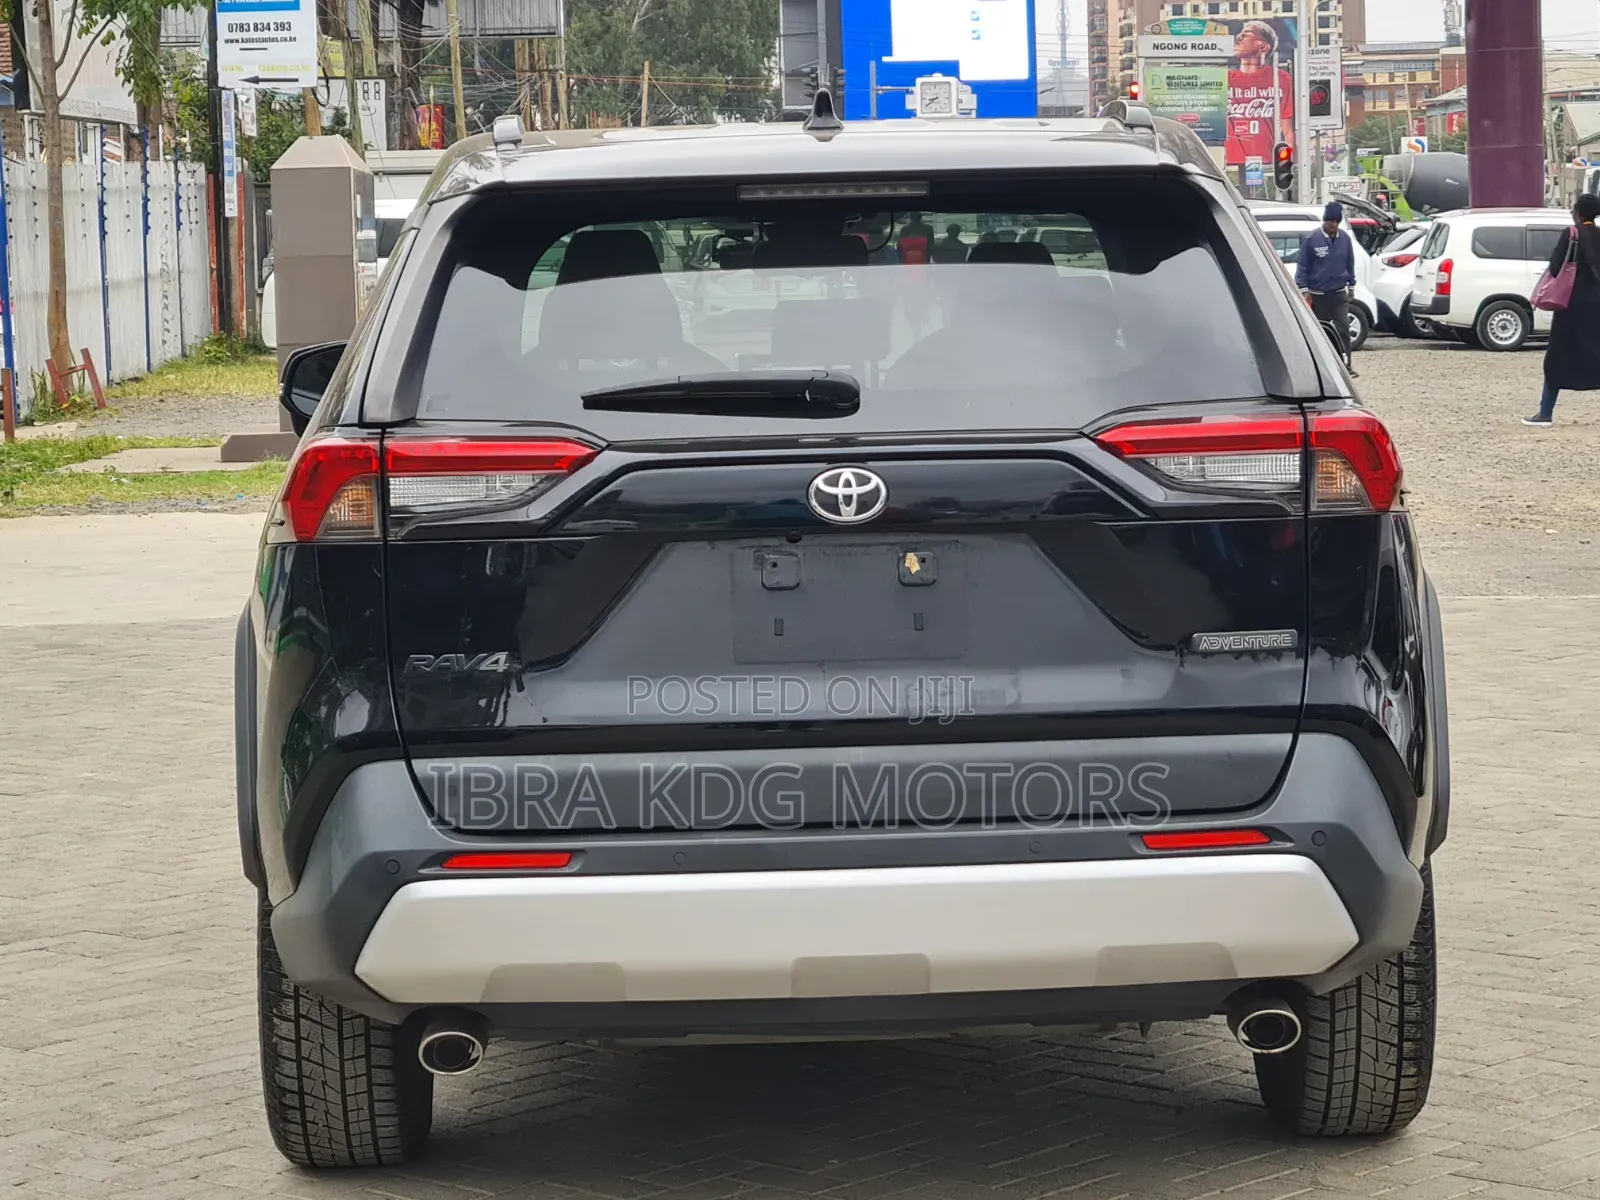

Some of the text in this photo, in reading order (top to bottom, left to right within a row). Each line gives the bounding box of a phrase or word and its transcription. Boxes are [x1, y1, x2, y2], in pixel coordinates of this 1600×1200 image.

[227, 21, 292, 33] 0783 834 393
[1152, 42, 1217, 51] NGONG ROAD
[1244, 86, 1257, 98] all
[1198, 634, 1292, 651] ADVENTURE
[403, 651, 509, 674] RAV4
